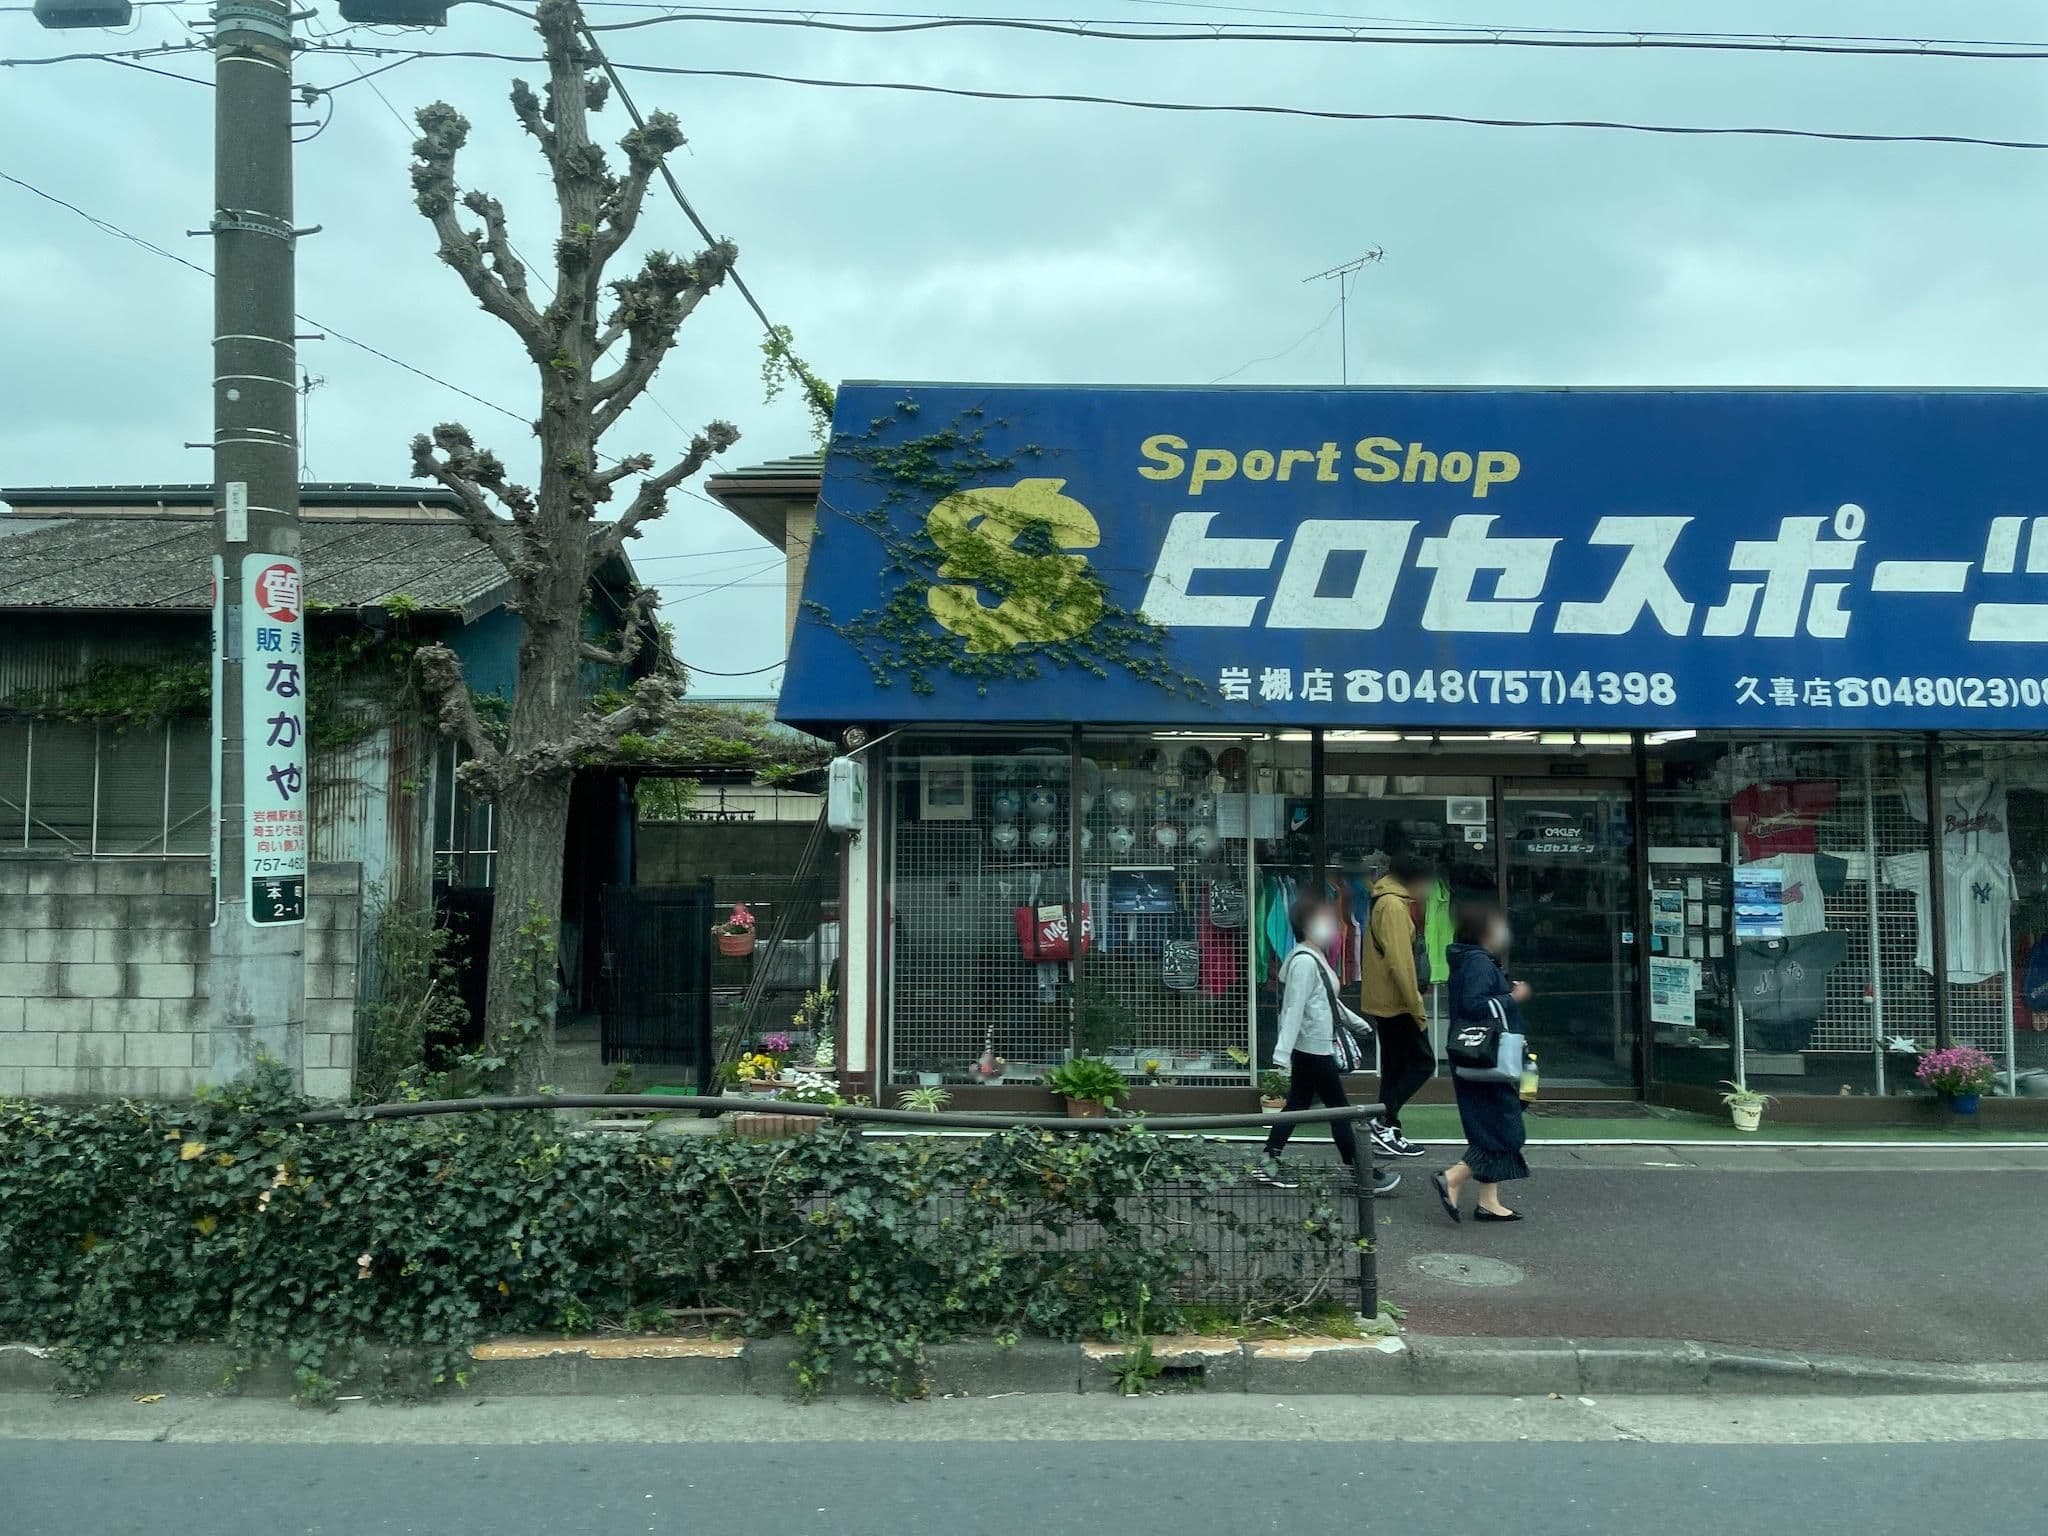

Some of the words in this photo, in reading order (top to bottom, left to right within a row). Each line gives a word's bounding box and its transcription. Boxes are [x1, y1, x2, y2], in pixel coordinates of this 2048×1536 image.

[1137, 434, 1342, 496] Sport
[1353, 436, 1522, 499] Shop
[263, 569, 301, 616] 質
[1219, 666, 1334, 703] 岩槻店
[1387, 669, 1677, 706] 048(757)4398
[1733, 675, 1833, 707] 久喜店
[266, 659, 302, 802] なかや
